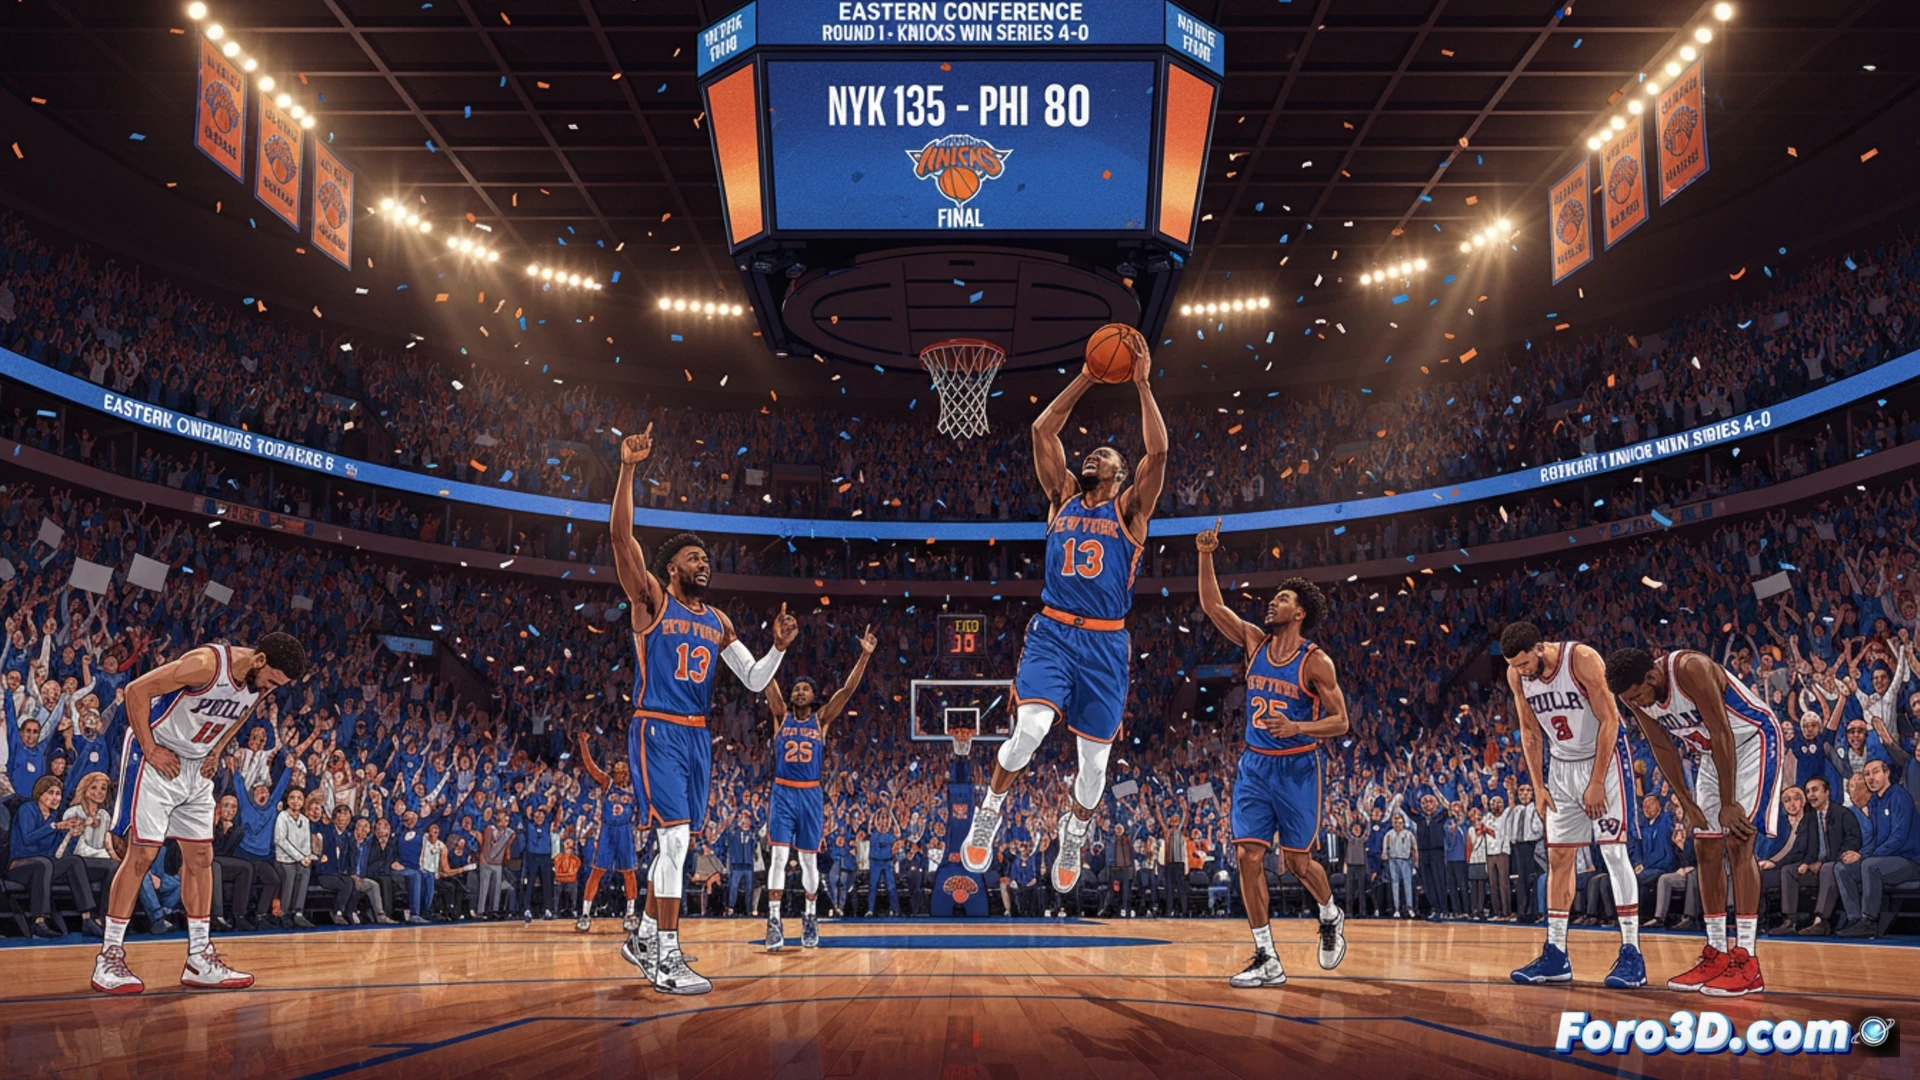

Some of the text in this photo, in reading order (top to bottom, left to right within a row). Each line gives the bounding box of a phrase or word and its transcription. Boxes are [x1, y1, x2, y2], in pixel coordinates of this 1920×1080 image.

[839, 2, 1083, 21] EASTERN CONFERENCE
[822, 24, 875, 41] ROUND
[959, 24, 992, 41] WIN
[996, 24, 1054, 41] SERIES
[1058, 24, 1089, 41] 4-0
[828, 85, 886, 126] NYK
[893, 84, 946, 127] 135
[979, 85, 1028, 126] PHI
[1044, 83, 1090, 127] 80
[937, 207, 984, 228] FINAL
[1061, 537, 1105, 579] 13
[674, 642, 711, 683] 13
[1251, 696, 1288, 729] 25
